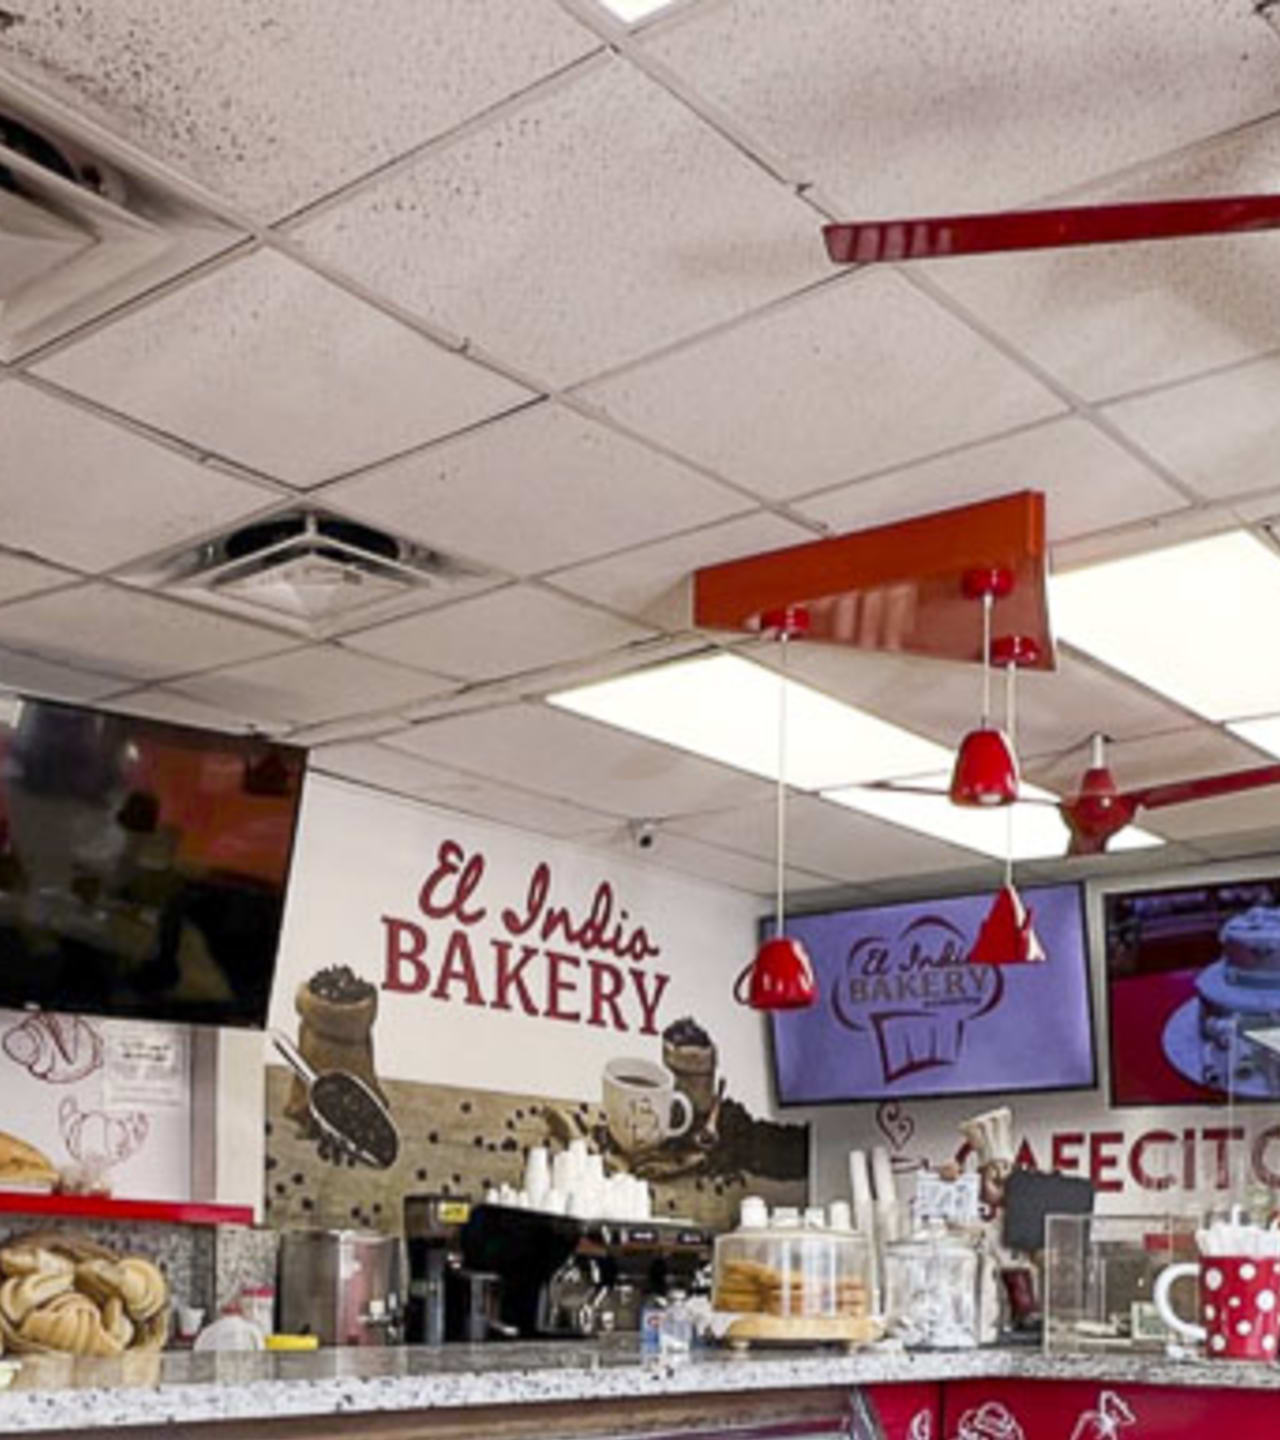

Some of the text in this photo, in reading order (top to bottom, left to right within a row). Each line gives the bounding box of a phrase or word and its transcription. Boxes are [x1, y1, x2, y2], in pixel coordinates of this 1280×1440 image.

[418, 838, 660, 962] El Indio
[380, 914, 671, 1036] BAKERY
[850, 963, 990, 1005] BAKERY
[898, 940, 972, 972] Indi
